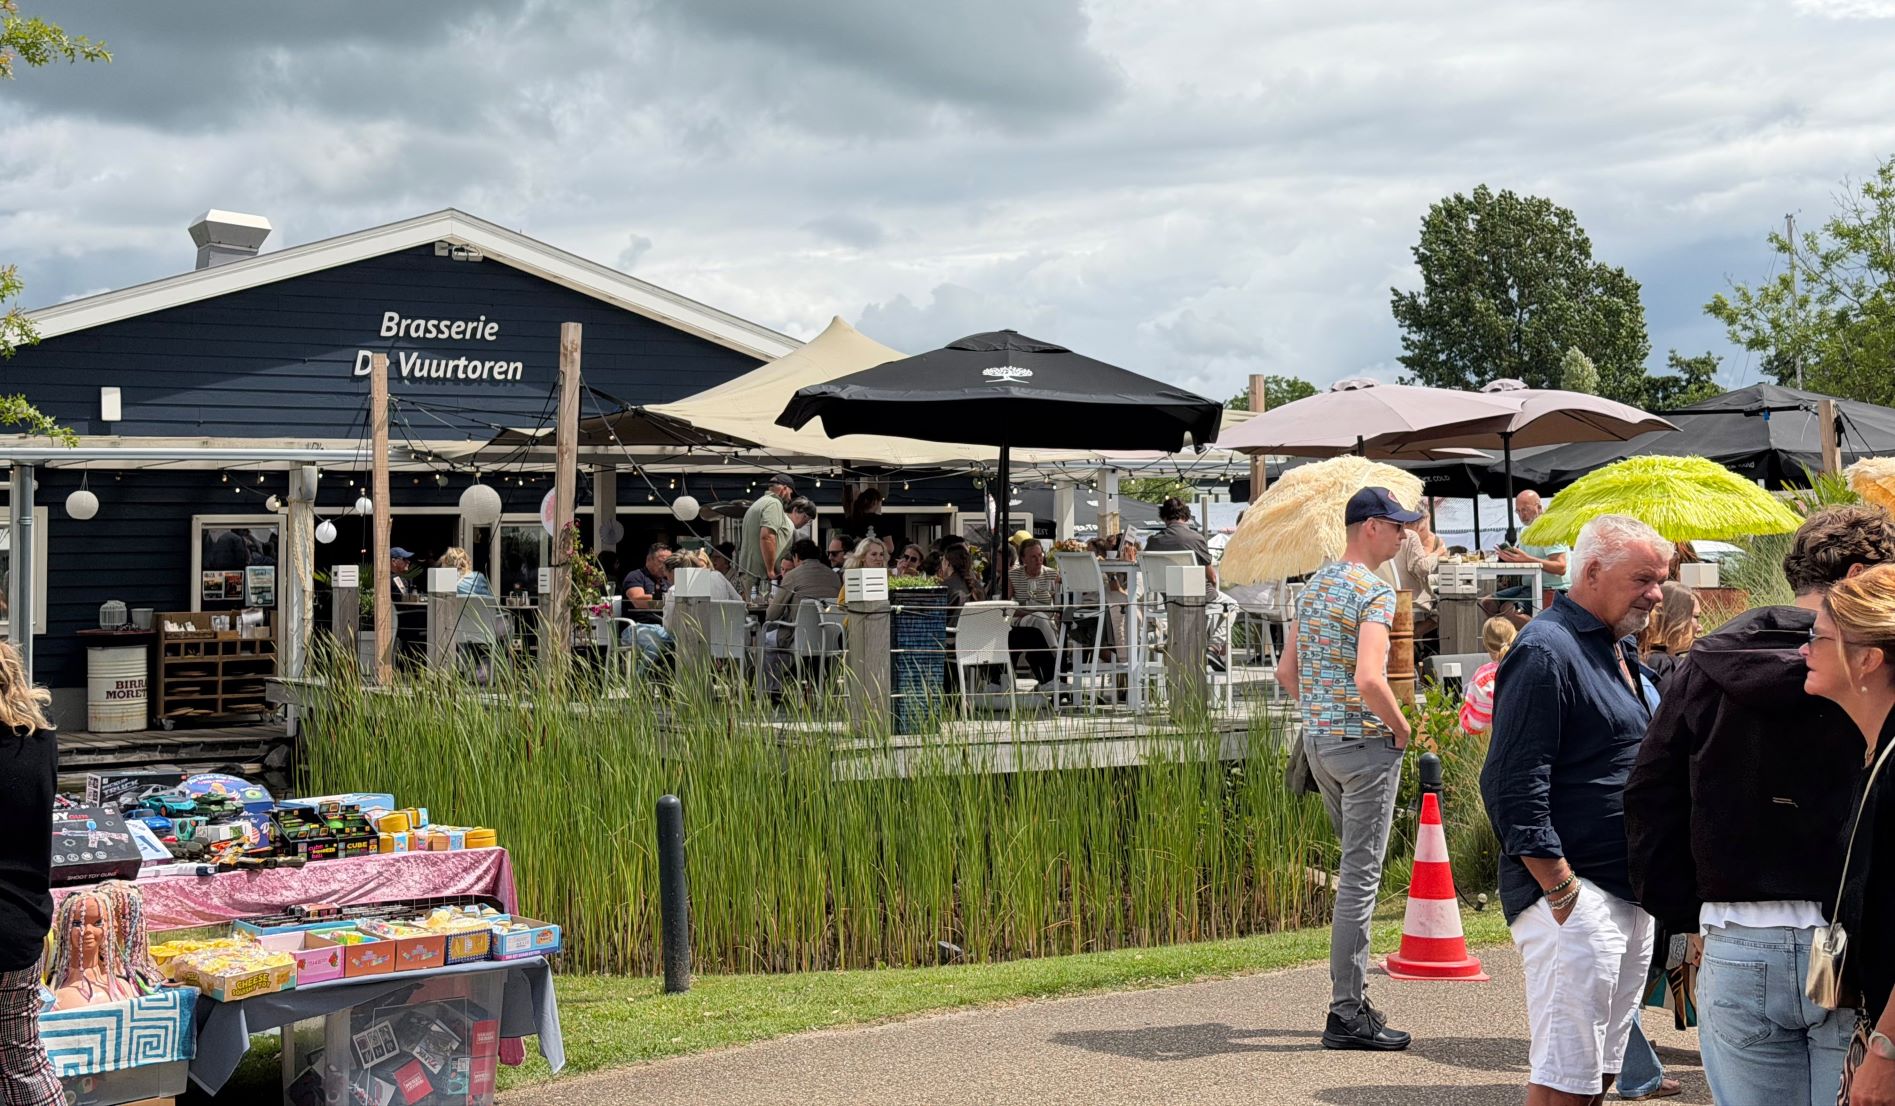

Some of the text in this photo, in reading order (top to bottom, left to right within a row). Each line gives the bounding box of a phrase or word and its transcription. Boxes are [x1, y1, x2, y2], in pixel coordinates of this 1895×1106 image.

[380, 311, 499, 341] Brasserie
[354, 350, 523, 380] D Vuurtoren
[115, 679, 147, 690] BIRR
[105, 689, 147, 700] MORET
[102, 779, 139, 796] TRUCK
[347, 841, 368, 849] CUBE
[236, 973, 270, 989] CHEESE
